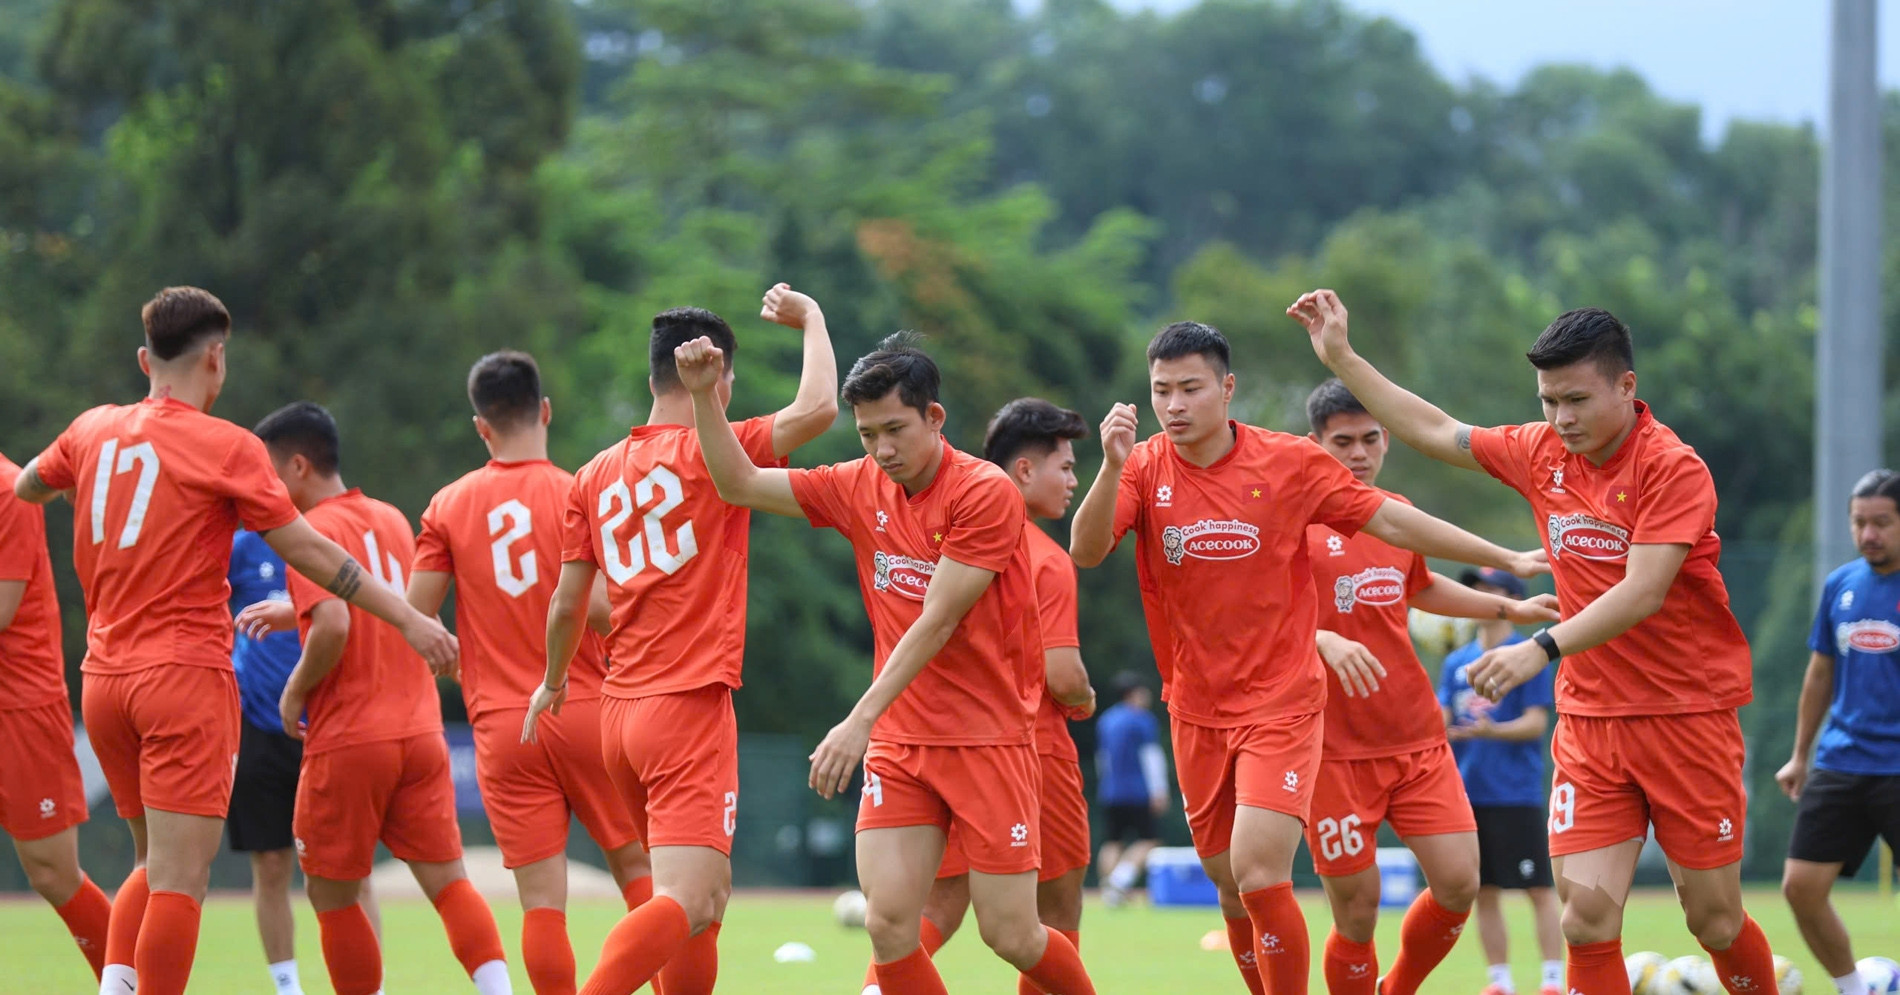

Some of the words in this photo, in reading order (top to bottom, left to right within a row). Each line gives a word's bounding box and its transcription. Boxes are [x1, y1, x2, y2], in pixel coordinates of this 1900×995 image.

[91, 437, 160, 550] 17
[598, 464, 699, 586] 22
[1182, 522, 1207, 537] Cook
[1209, 521, 1258, 535] happiness
[1561, 516, 1582, 528] Cook
[1583, 516, 1626, 538] happiness
[487, 498, 539, 598] 2
[1317, 813, 1364, 861] 26
